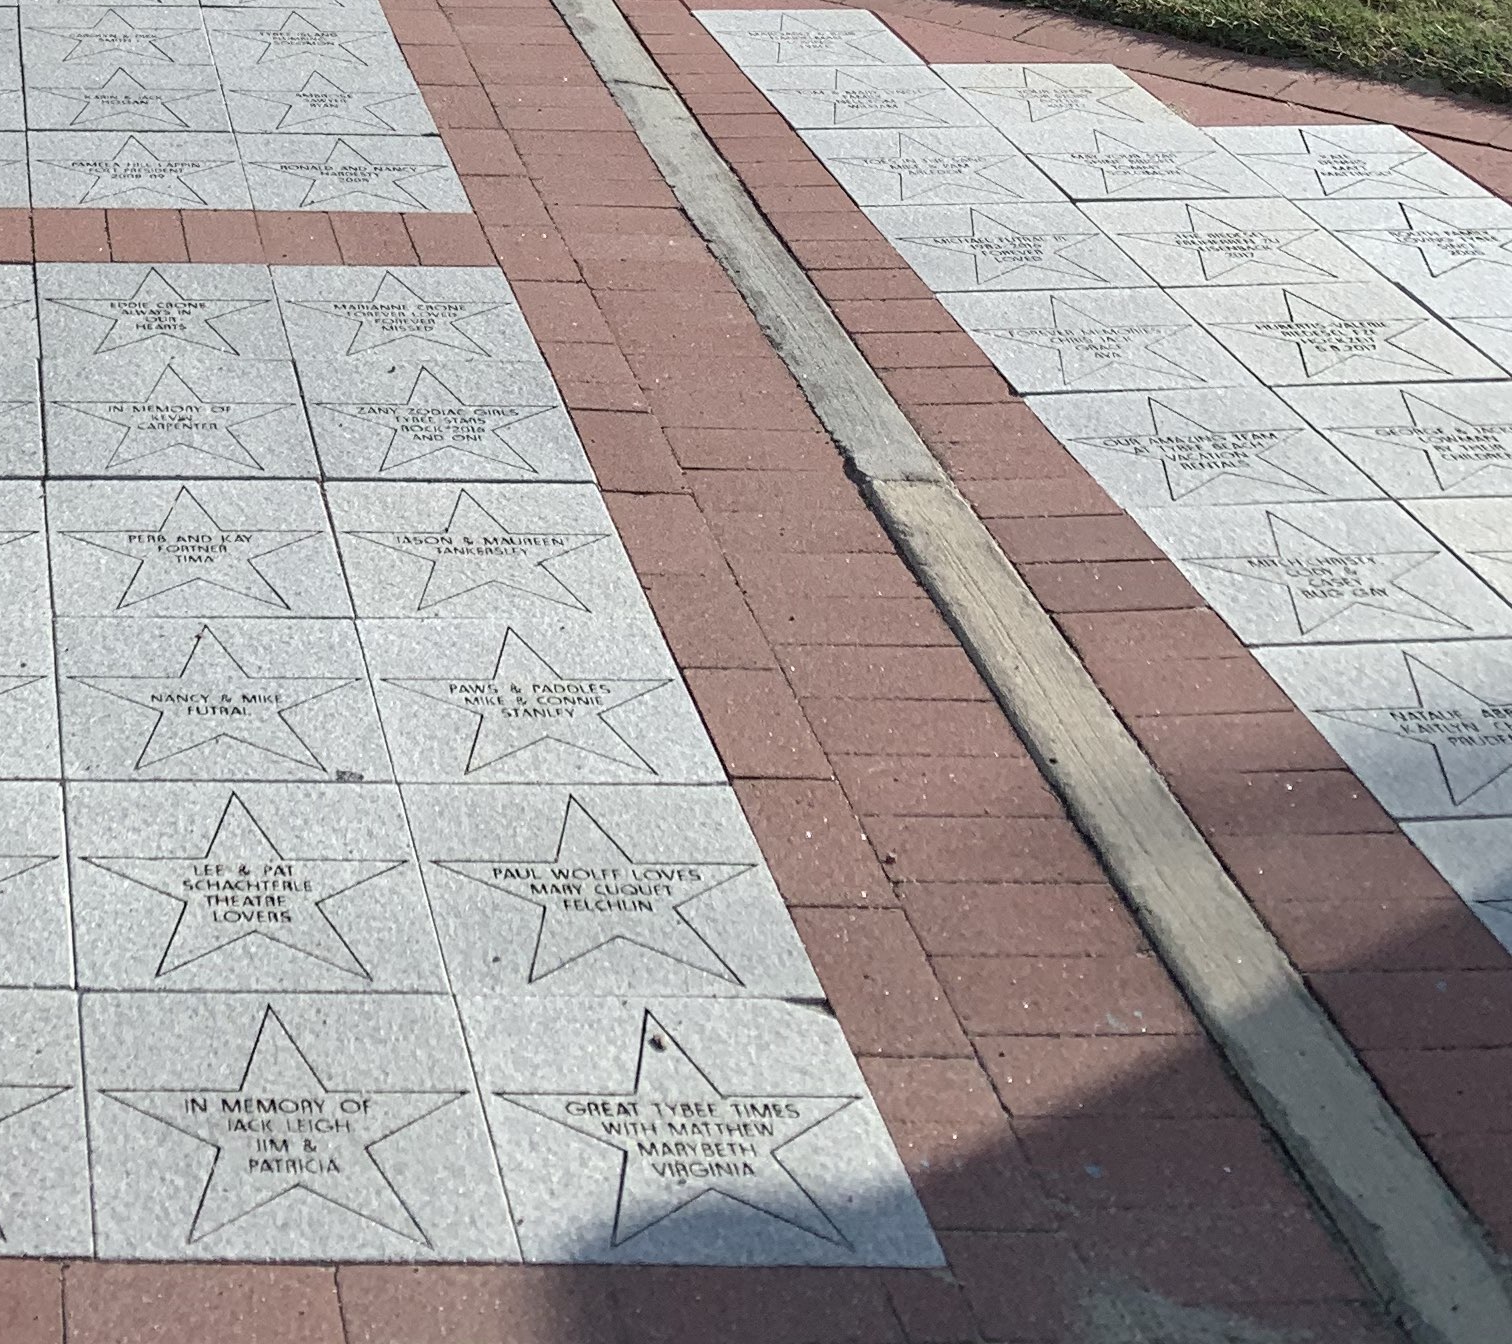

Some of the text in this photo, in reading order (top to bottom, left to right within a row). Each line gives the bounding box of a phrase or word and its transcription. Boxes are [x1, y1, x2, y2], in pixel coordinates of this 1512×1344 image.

[108, 405, 232, 413] IN MEMORY OF
[357, 406, 519, 417] ZANY ZODIAC GIRLS
[137, 422, 218, 430] CARPENTER
[444, 416, 487, 424] STARS
[412, 433, 444, 442] AND
[1102, 432, 1278, 447] OUR AMAZING TEAM
[1133, 442, 1265, 455] AT TYBEE BEACH
[1165, 452, 1249, 462] VACATION
[1180, 460, 1251, 471] RENTALS
[176, 534, 253, 543] AND KAY
[396, 536, 565, 546] JASON & MAUREEN
[437, 546, 529, 556] TANKERSLEY
[1286, 566, 1357, 577] CODY &
[1308, 577, 1362, 587] CASEY
[449, 683, 611, 695] PAWS & PADDLES
[151, 694, 284, 704] NANCY & MIKE
[465, 695, 603, 706] MIKE & CONNIE
[188, 706, 252, 717] FUTRAL
[501, 707, 575, 718] STANLEY
[1400, 722, 1479, 733] KAITLYN
[193, 865, 295, 877] LEE & PAT
[493, 867, 702, 882] PAUL WOLFF LOVES
[183, 879, 313, 892] SCHACHTERLE
[530, 884, 583, 896] MARY
[204, 895, 286, 907] THEATRE
[564, 899, 654, 912] FELCHLIN
[213, 910, 292, 924] LOVERS
[184, 1098, 372, 1115] IN MEMORY OF
[565, 1102, 800, 1119] GREAT TYBEE TIMES
[228, 1119, 350, 1133] JACK LEIGH
[601, 1121, 774, 1138] WITH MATTHEW
[256, 1138, 317, 1153] JIM &
[638, 1142, 757, 1157] MARYBETH
[249, 1158, 340, 1174] PATRICIA
[651, 1162, 757, 1178] VIRGINIA
